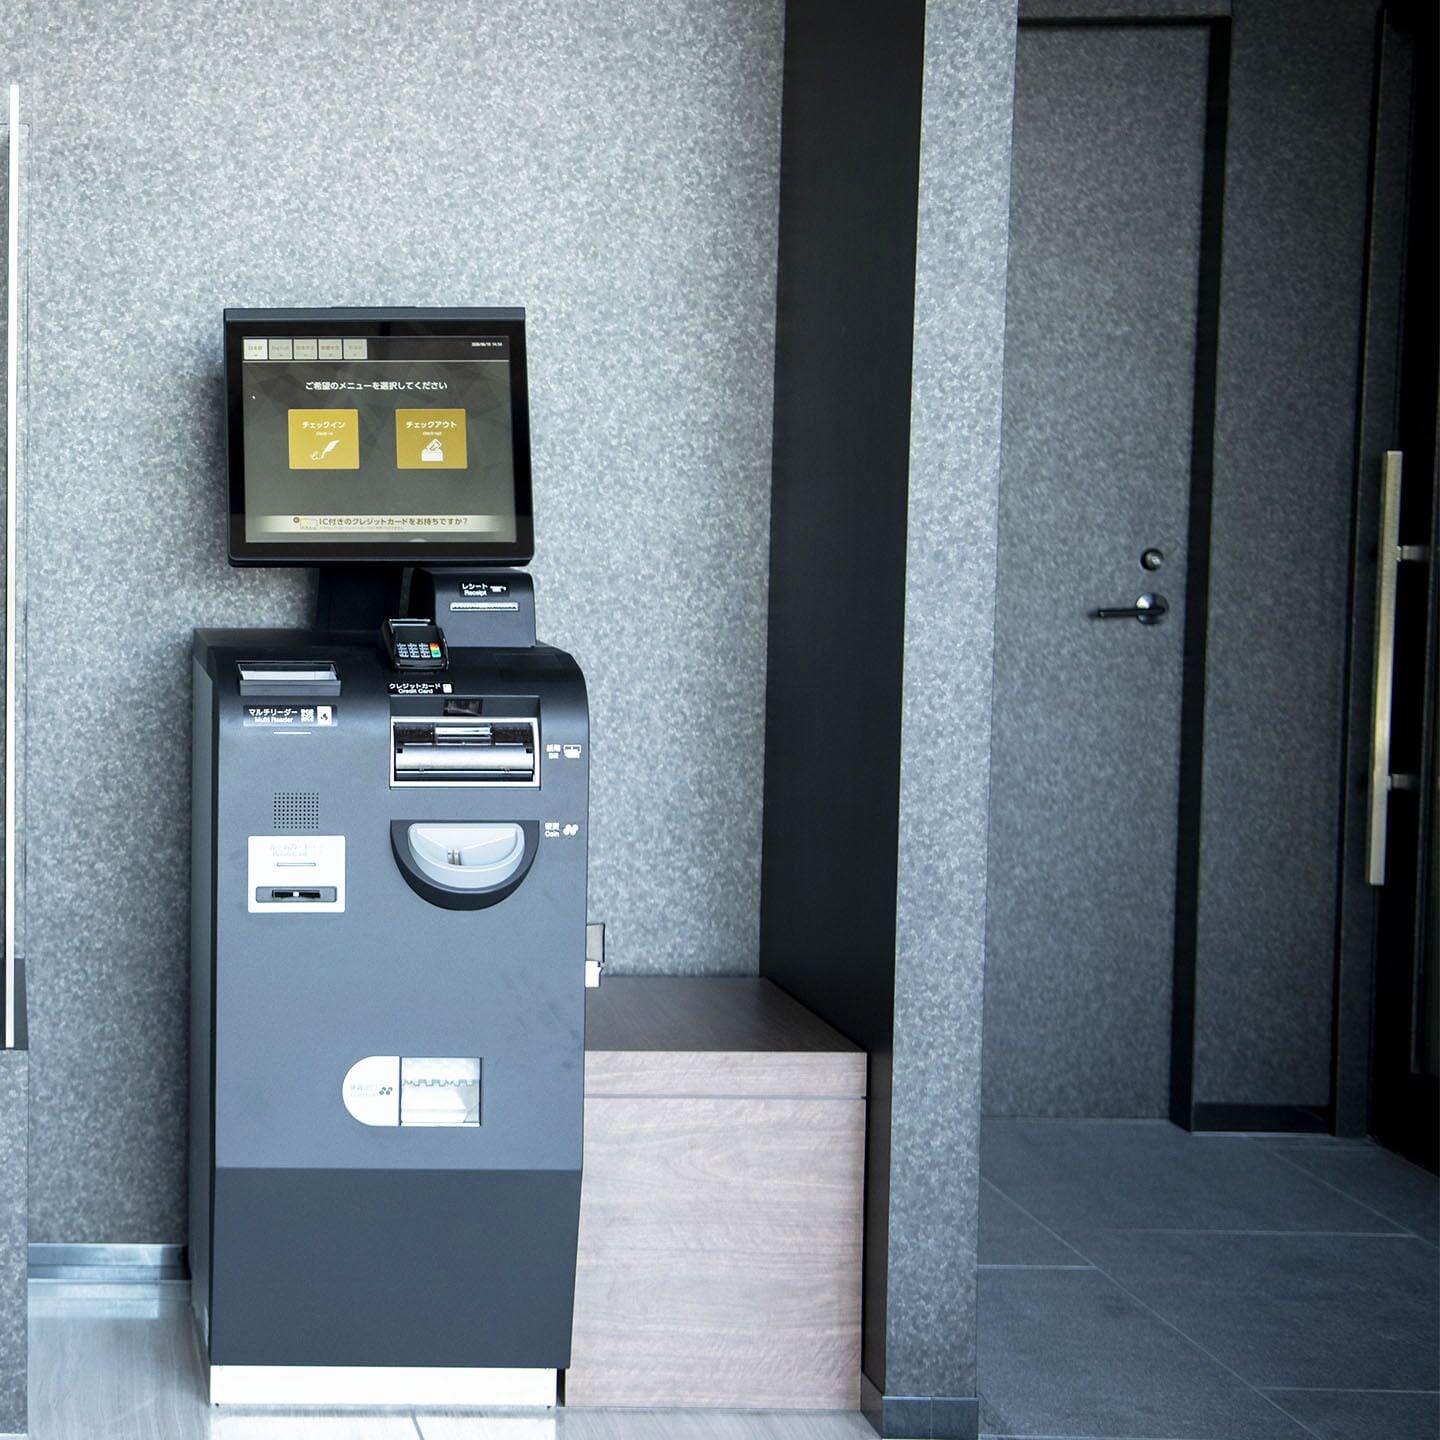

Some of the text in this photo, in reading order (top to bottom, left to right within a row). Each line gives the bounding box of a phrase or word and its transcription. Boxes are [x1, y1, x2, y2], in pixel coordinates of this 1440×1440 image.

[305, 381, 448, 391] ご希望のメニューを選択してください
[302, 421, 346, 429] チェックイン
[406, 421, 457, 429] チェックアウト
[248, 708, 298, 716] マルチリーダー
